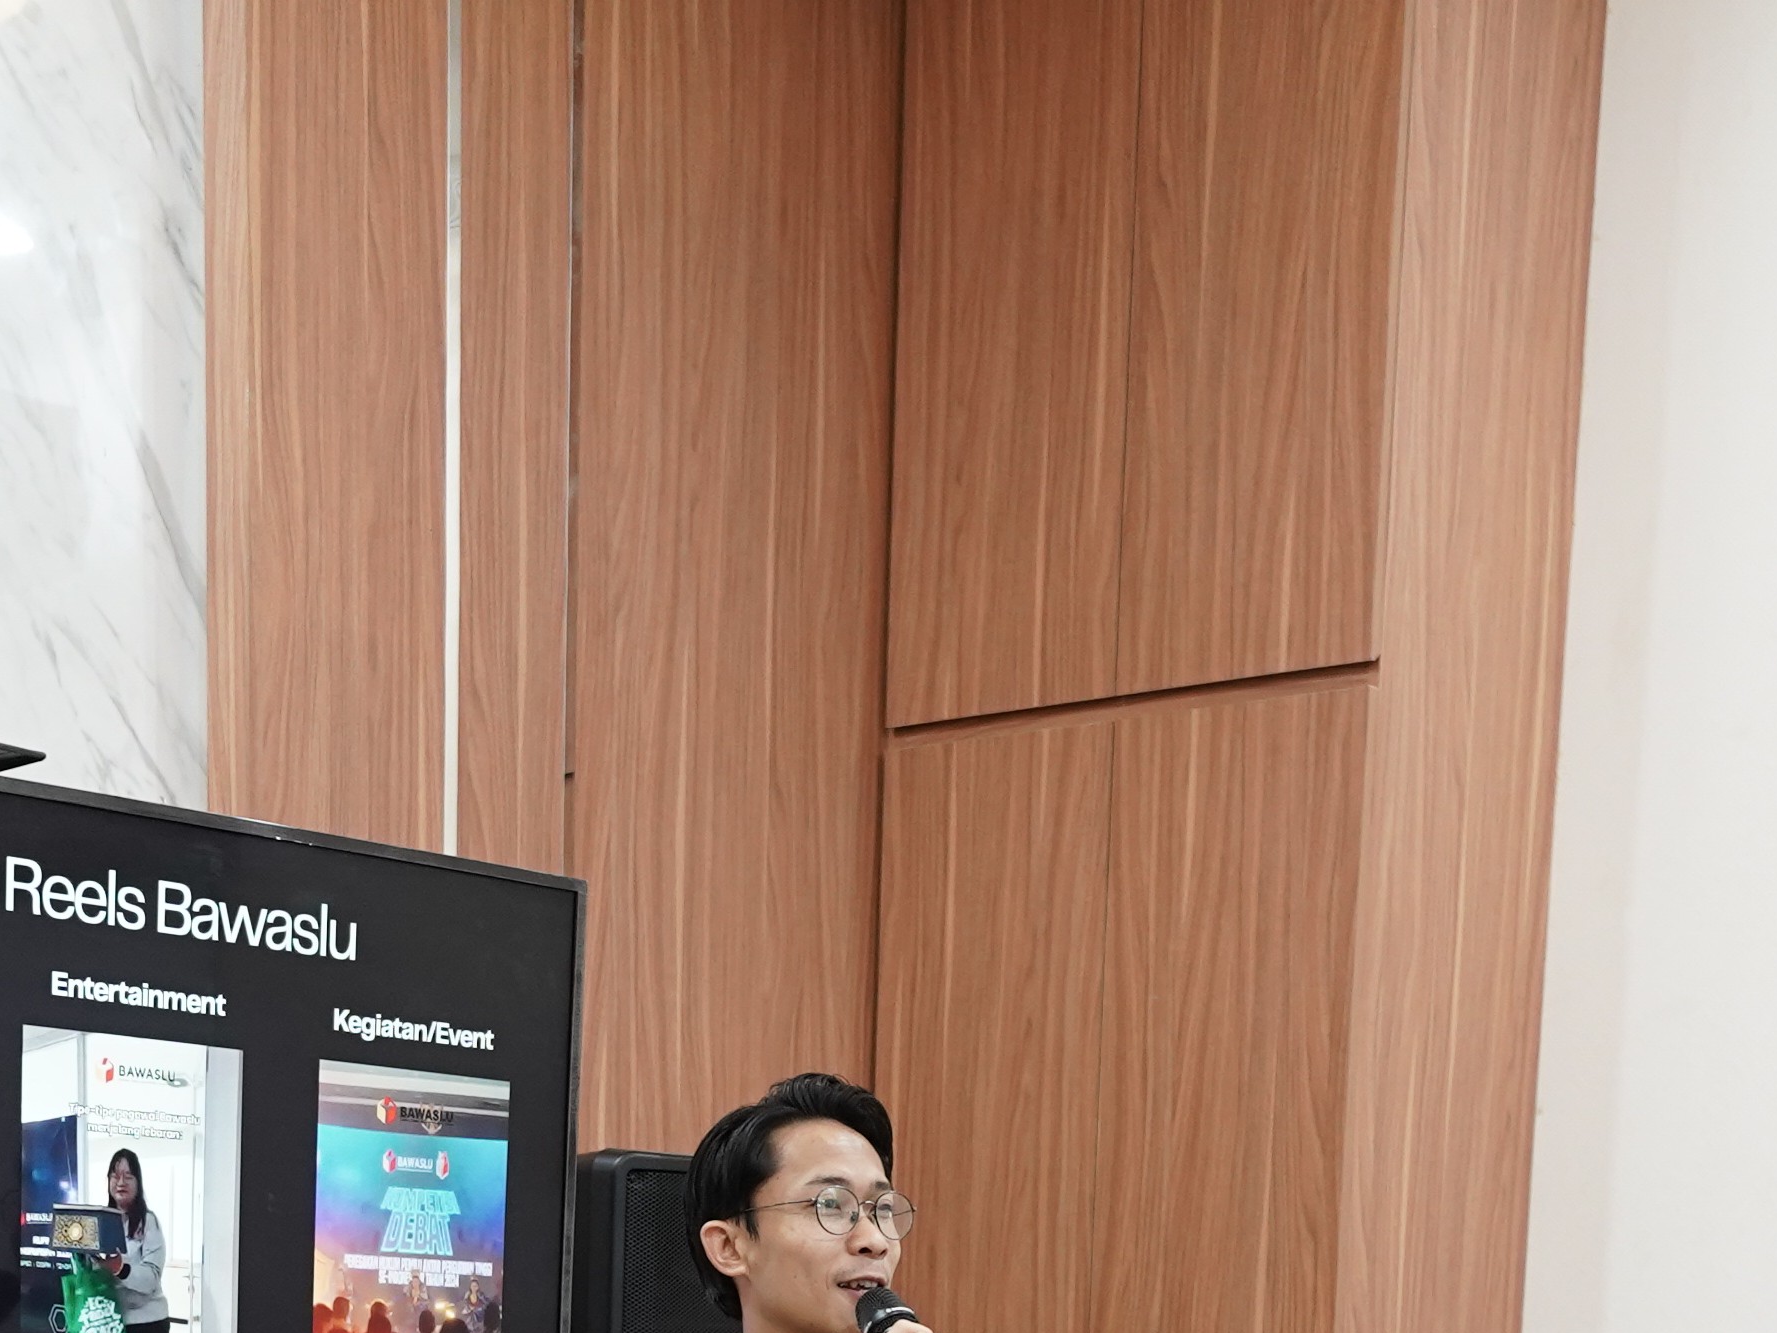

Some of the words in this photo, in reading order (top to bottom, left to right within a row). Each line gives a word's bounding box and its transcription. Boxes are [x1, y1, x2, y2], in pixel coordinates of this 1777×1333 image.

[5, 856, 146, 929] Reels
[156, 880, 357, 961] Bawaslu
[51, 971, 227, 1016] Entertainment
[333, 1007, 495, 1051] Kegiatan/Event
[119, 1065, 176, 1082] BAWASLU
[400, 1107, 453, 1122] BAWASLU
[398, 1157, 432, 1169] BAWASLU
[380, 1212, 453, 1256] DEBAT
